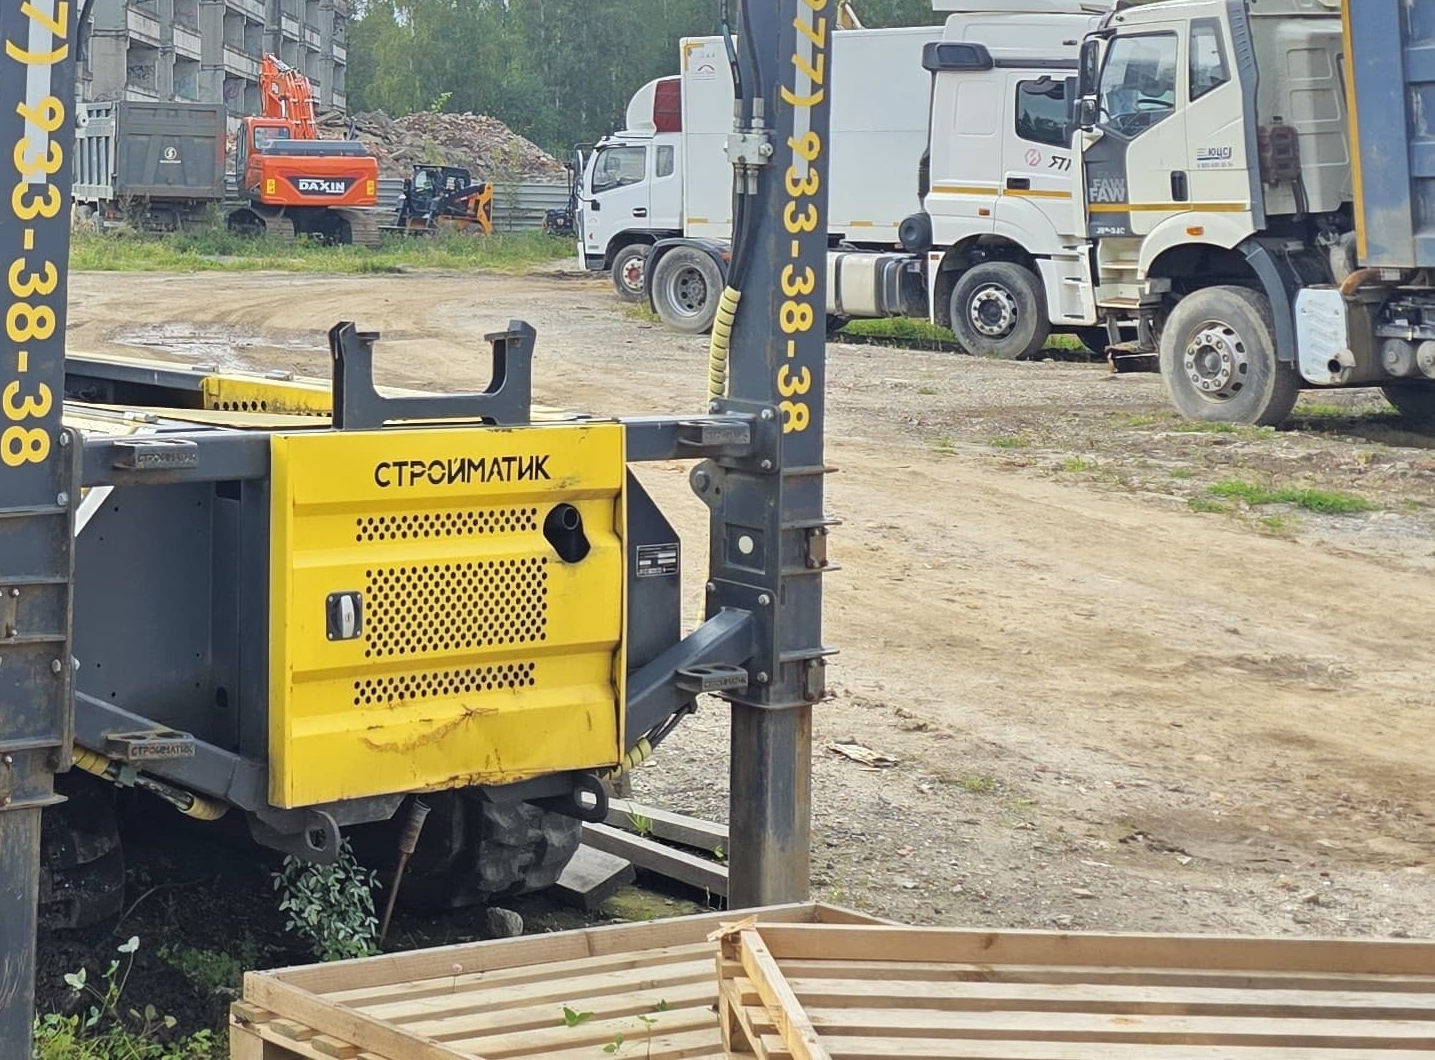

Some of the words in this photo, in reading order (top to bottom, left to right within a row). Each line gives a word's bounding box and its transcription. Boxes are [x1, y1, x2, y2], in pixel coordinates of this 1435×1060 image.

[298, 178, 345, 193] DAXIN
[1089, 187, 1125, 202] FAW
[0, 96, 64, 467] 933-38-38
[777, 131, 821, 433] 933-38-38
[374, 455, 552, 488] СТРОЙМАТИК
